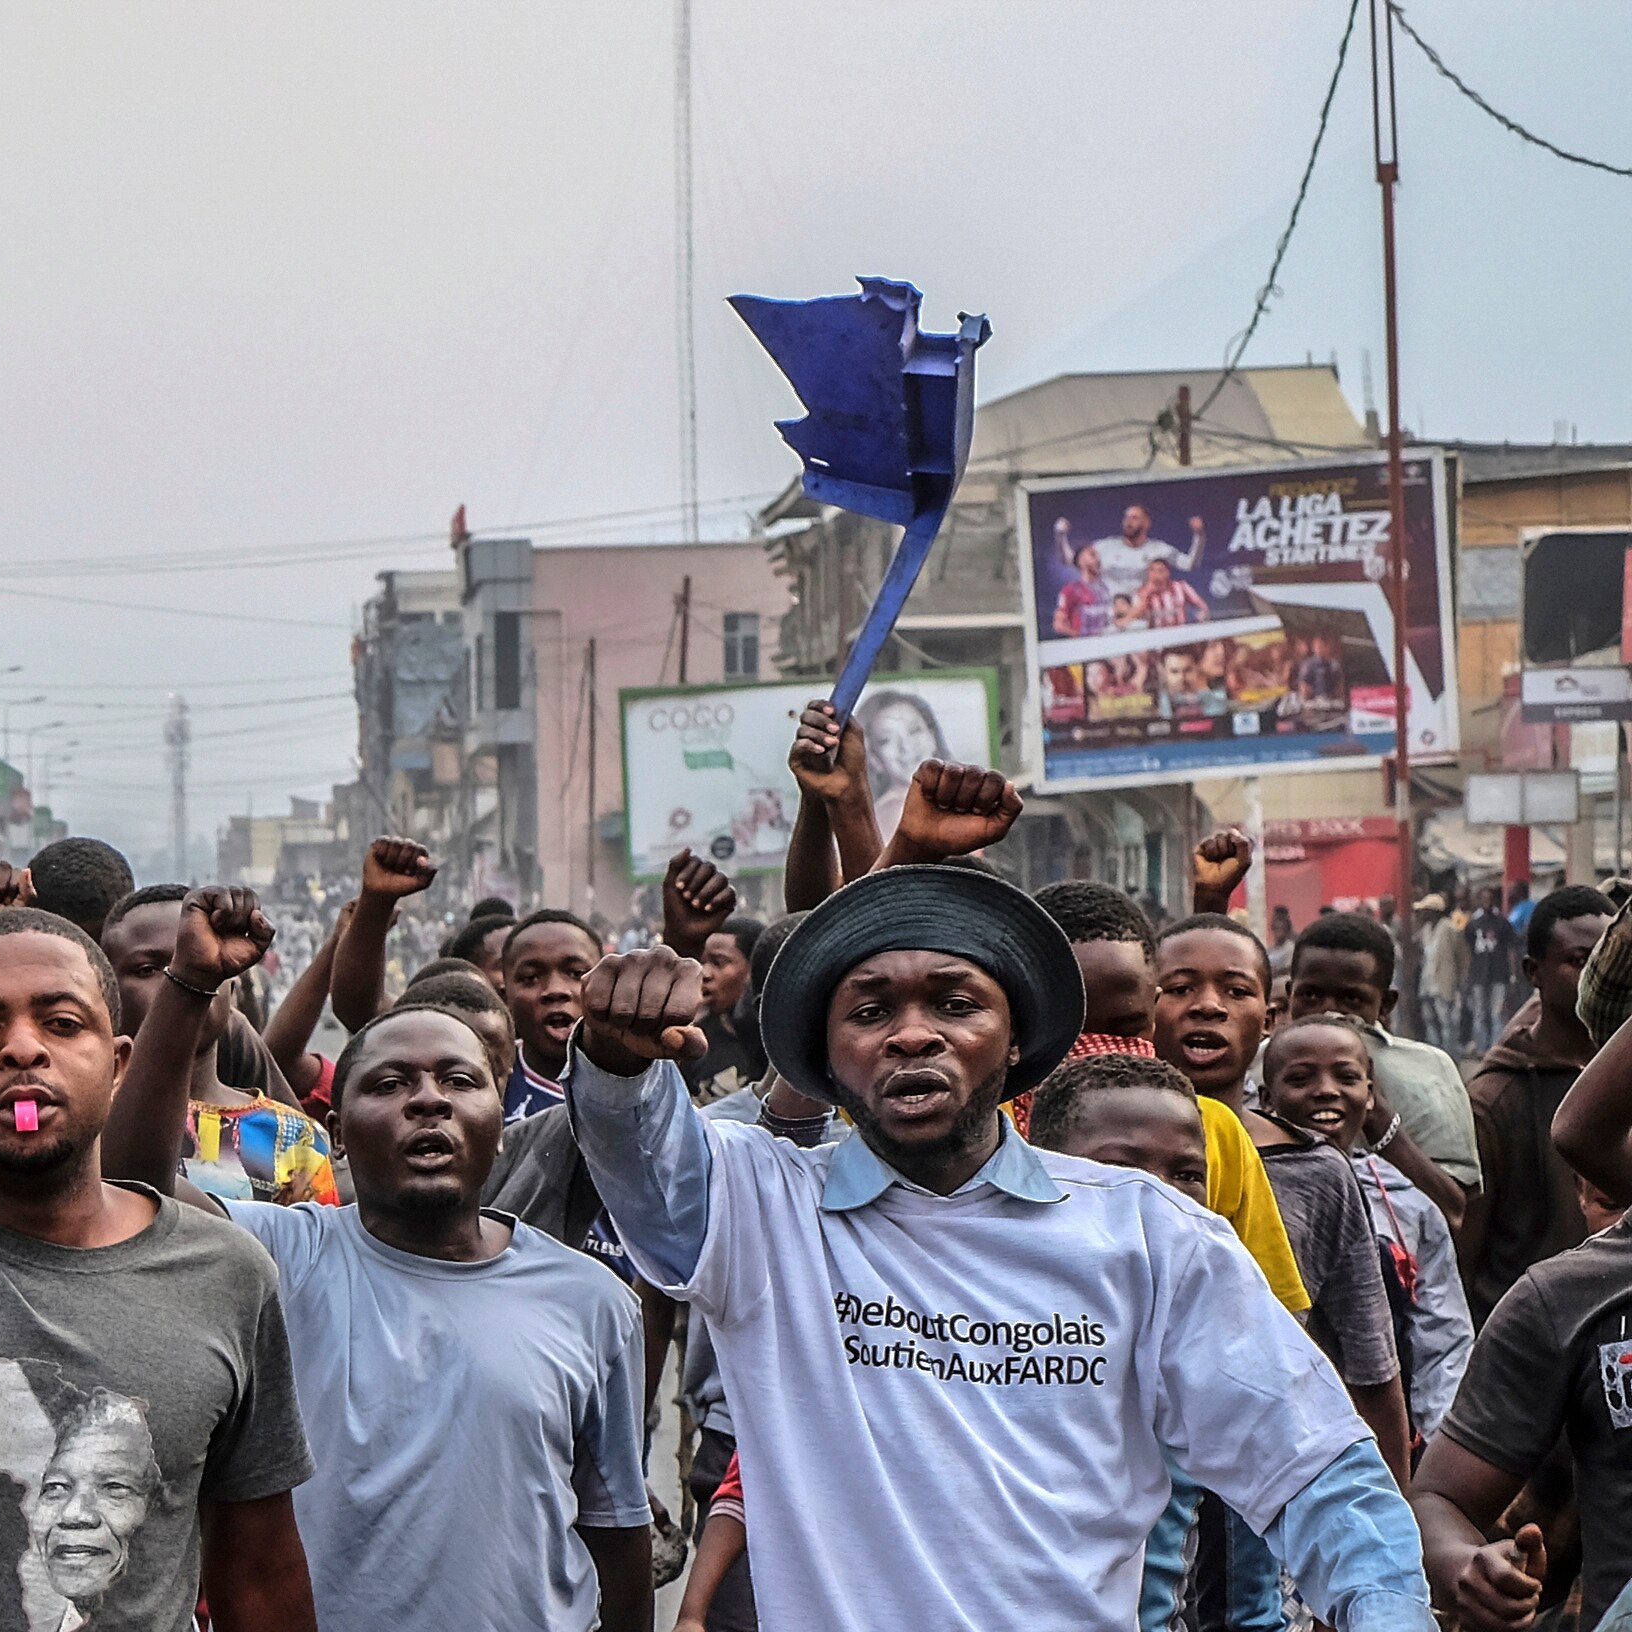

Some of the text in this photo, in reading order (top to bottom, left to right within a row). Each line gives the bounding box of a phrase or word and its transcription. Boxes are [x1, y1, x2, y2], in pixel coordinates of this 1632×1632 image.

[1236, 491, 1343, 521] LA LIGA
[1227, 509, 1393, 553] ACHETEZ
[843, 1334, 1108, 1386] SoutienAuxFARDC
